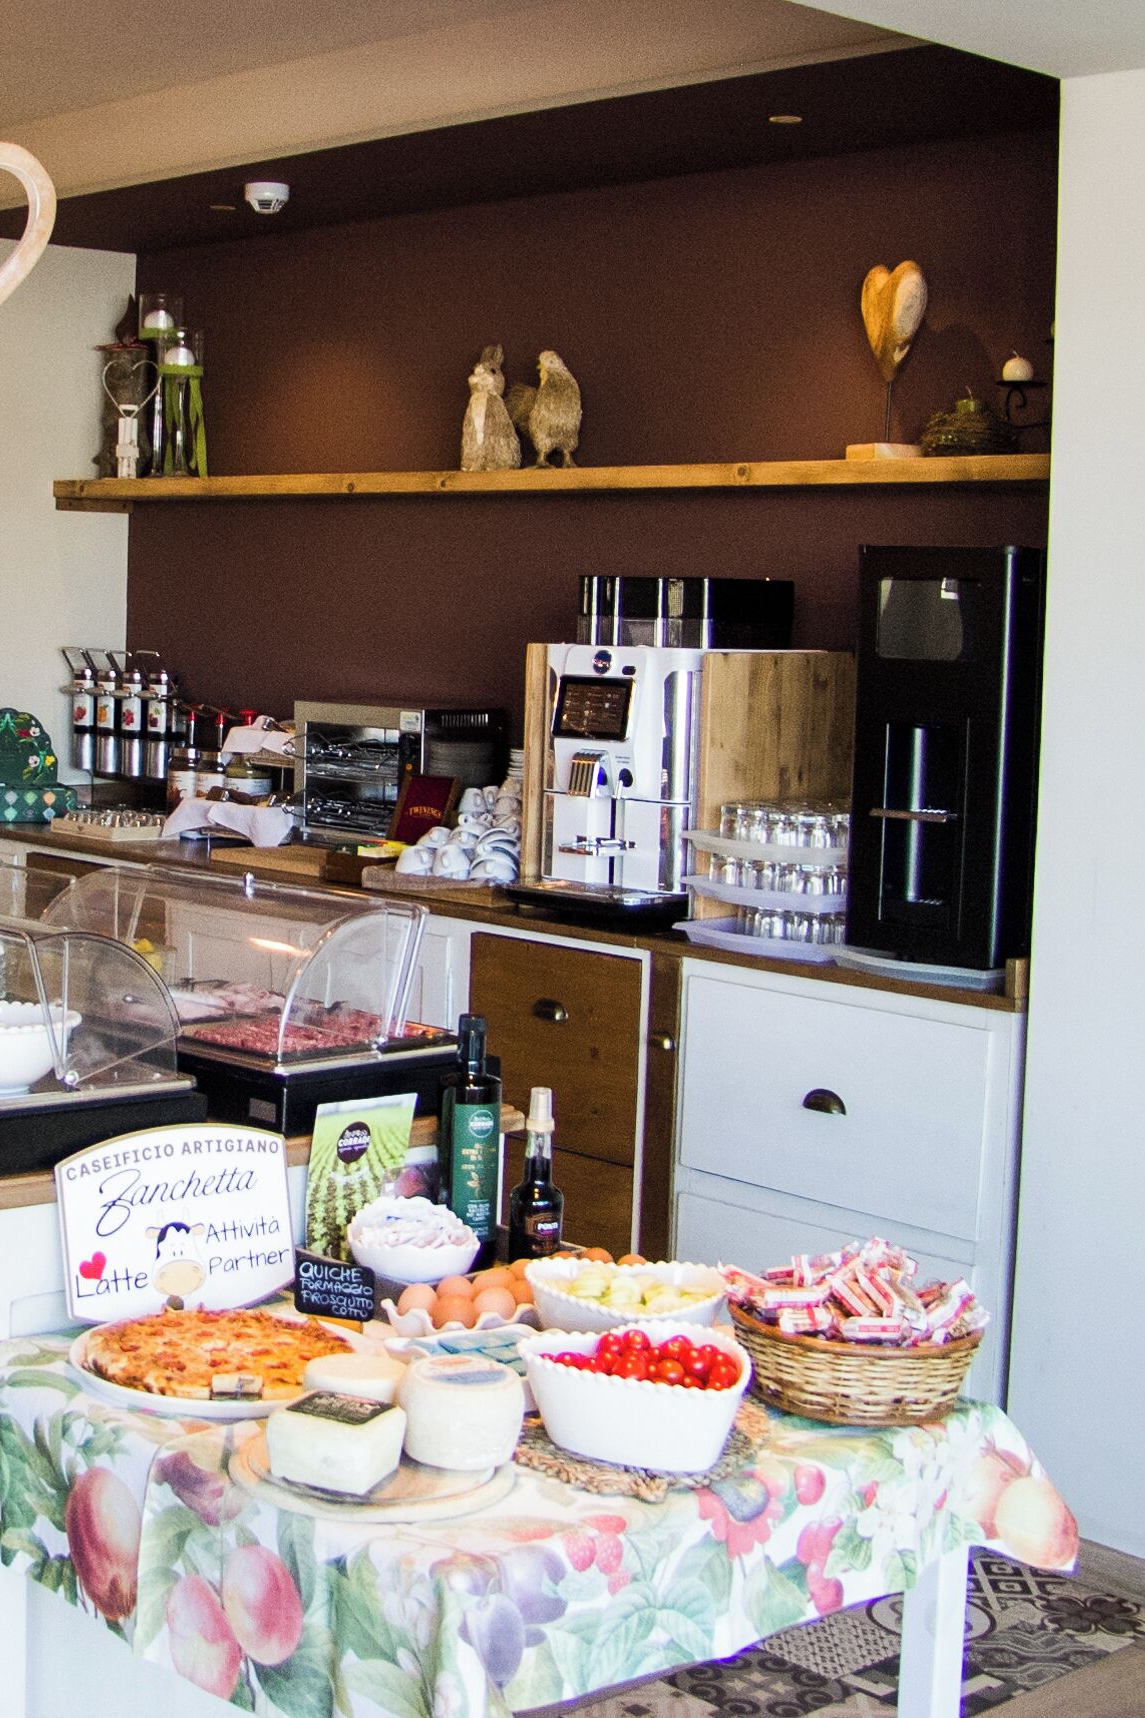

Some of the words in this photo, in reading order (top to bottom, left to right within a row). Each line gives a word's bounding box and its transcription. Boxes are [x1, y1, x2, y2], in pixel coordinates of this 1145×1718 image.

[65, 1144, 174, 1181] CASEIFICIO
[181, 1139, 280, 1156] ARTIGIANO
[96, 1167, 257, 1237] Zanchetta
[206, 1216, 280, 1244] Attività
[209, 1248, 290, 1275] Partner
[299, 1262, 363, 1282] QUICHE
[76, 1267, 149, 1298] Latte
[300, 1278, 373, 1295] FORMAGGIO
[332, 1305, 368, 1318] COTTO
